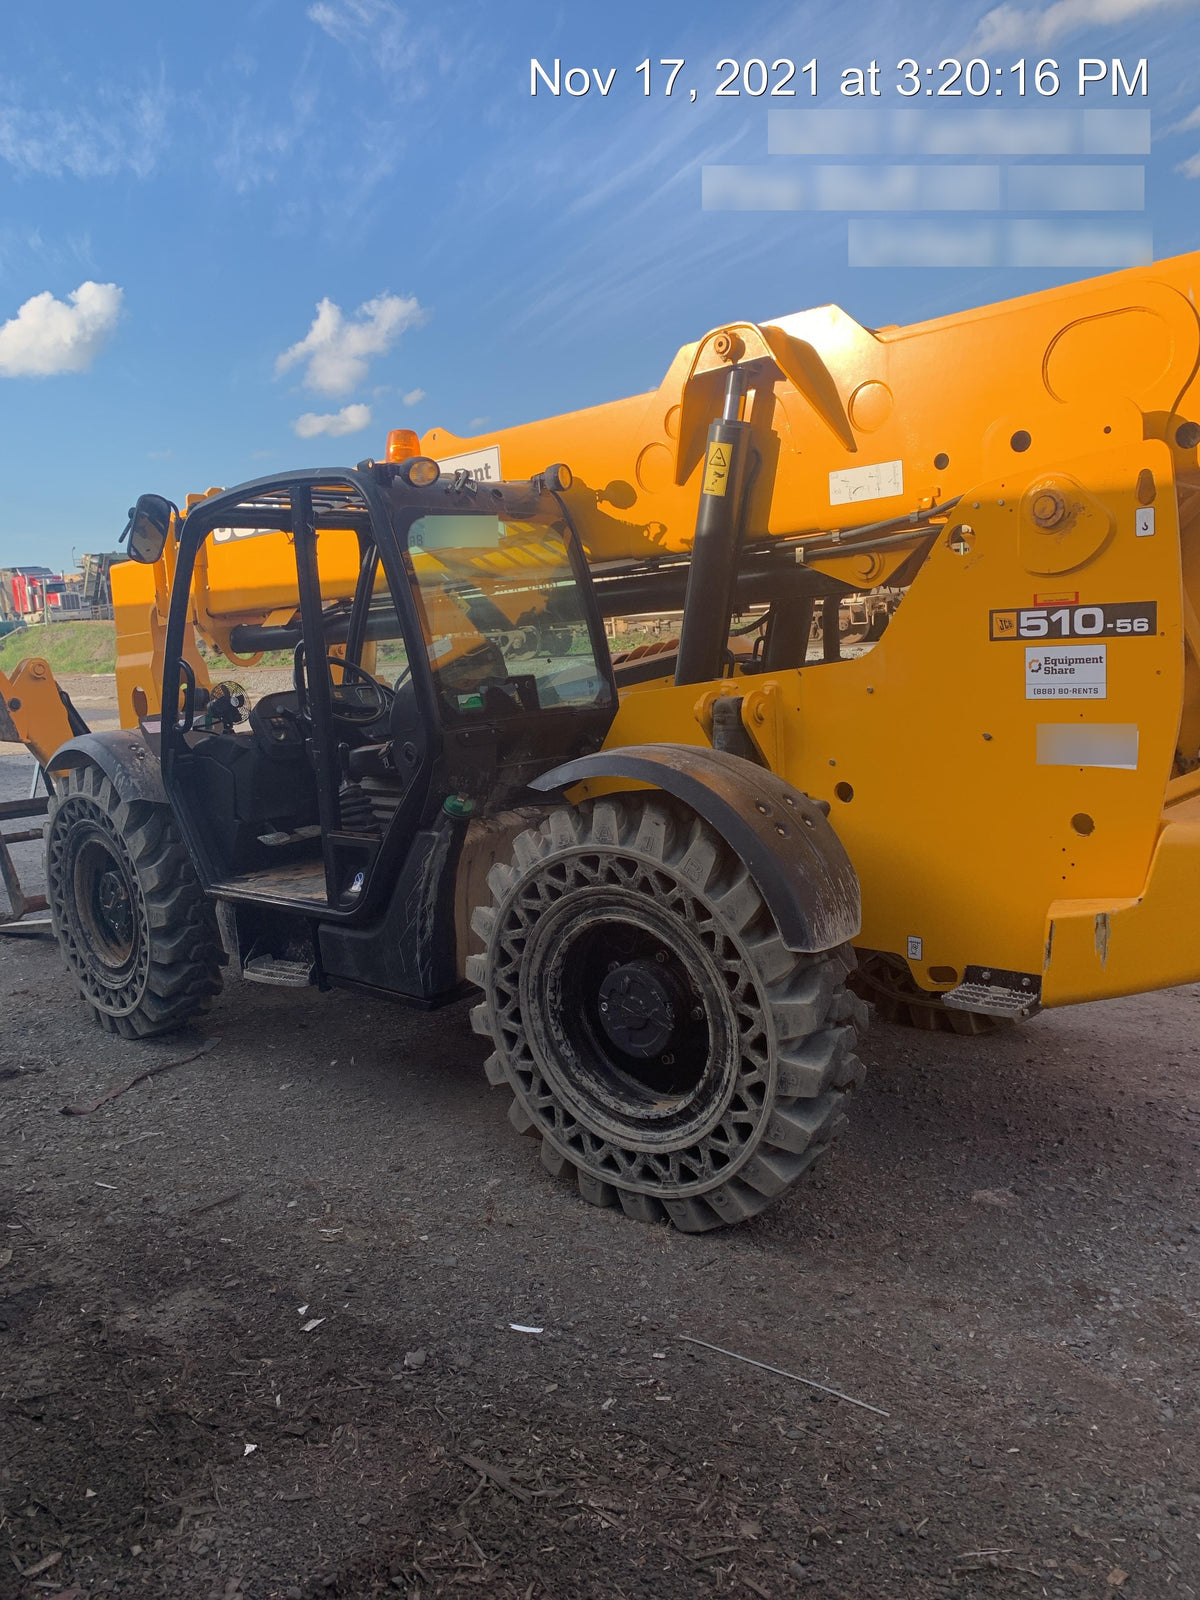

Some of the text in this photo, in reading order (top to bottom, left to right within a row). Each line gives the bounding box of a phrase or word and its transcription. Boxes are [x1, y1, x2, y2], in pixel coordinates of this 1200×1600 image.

[1043, 655, 1104, 667] Equipment
[1043, 666, 1076, 675] Share
[1033, 687, 1099, 696] (888) 80-RENTS
